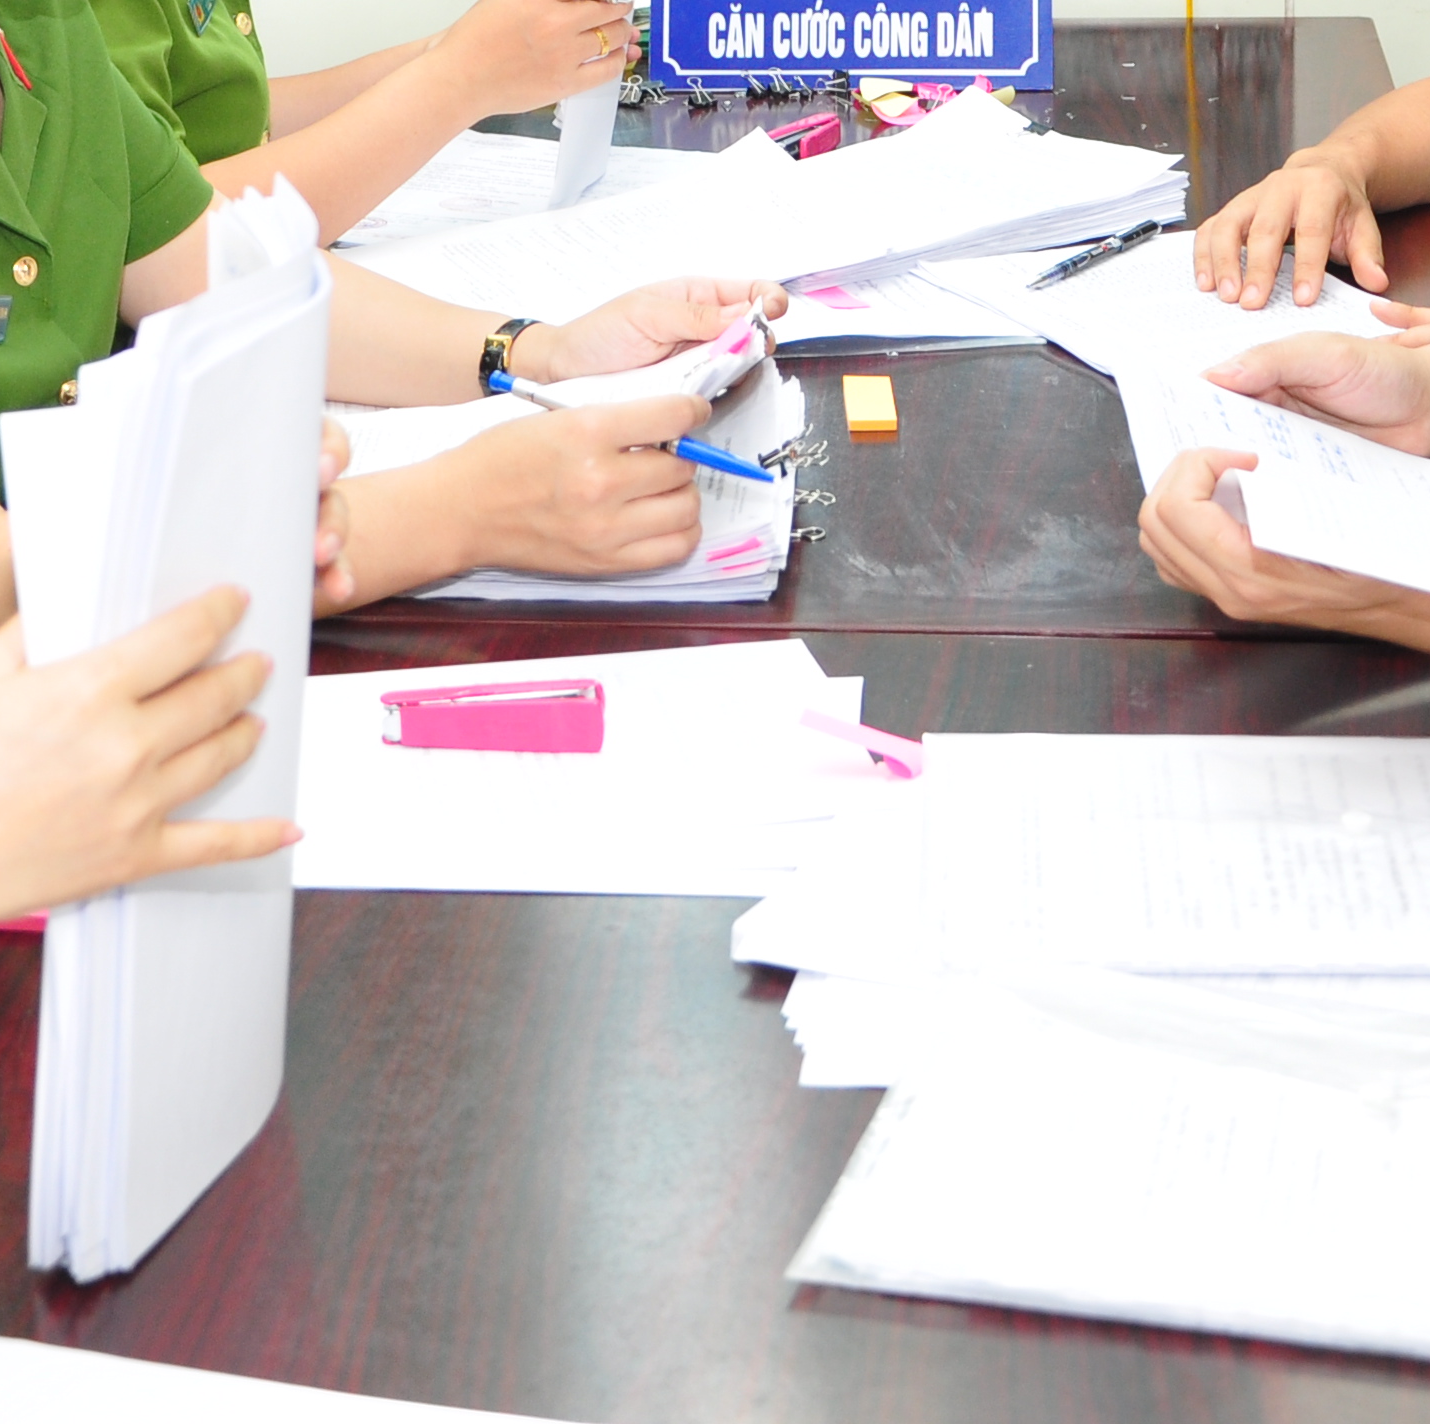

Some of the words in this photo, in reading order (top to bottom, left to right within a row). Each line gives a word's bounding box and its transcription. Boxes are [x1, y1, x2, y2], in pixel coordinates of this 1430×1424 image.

[709, 3, 764, 59] CĂN
[773, 0, 845, 59] CƯỚC
[854, 3, 928, 58] CÔNG
[937, 2, 993, 57] DÂN
